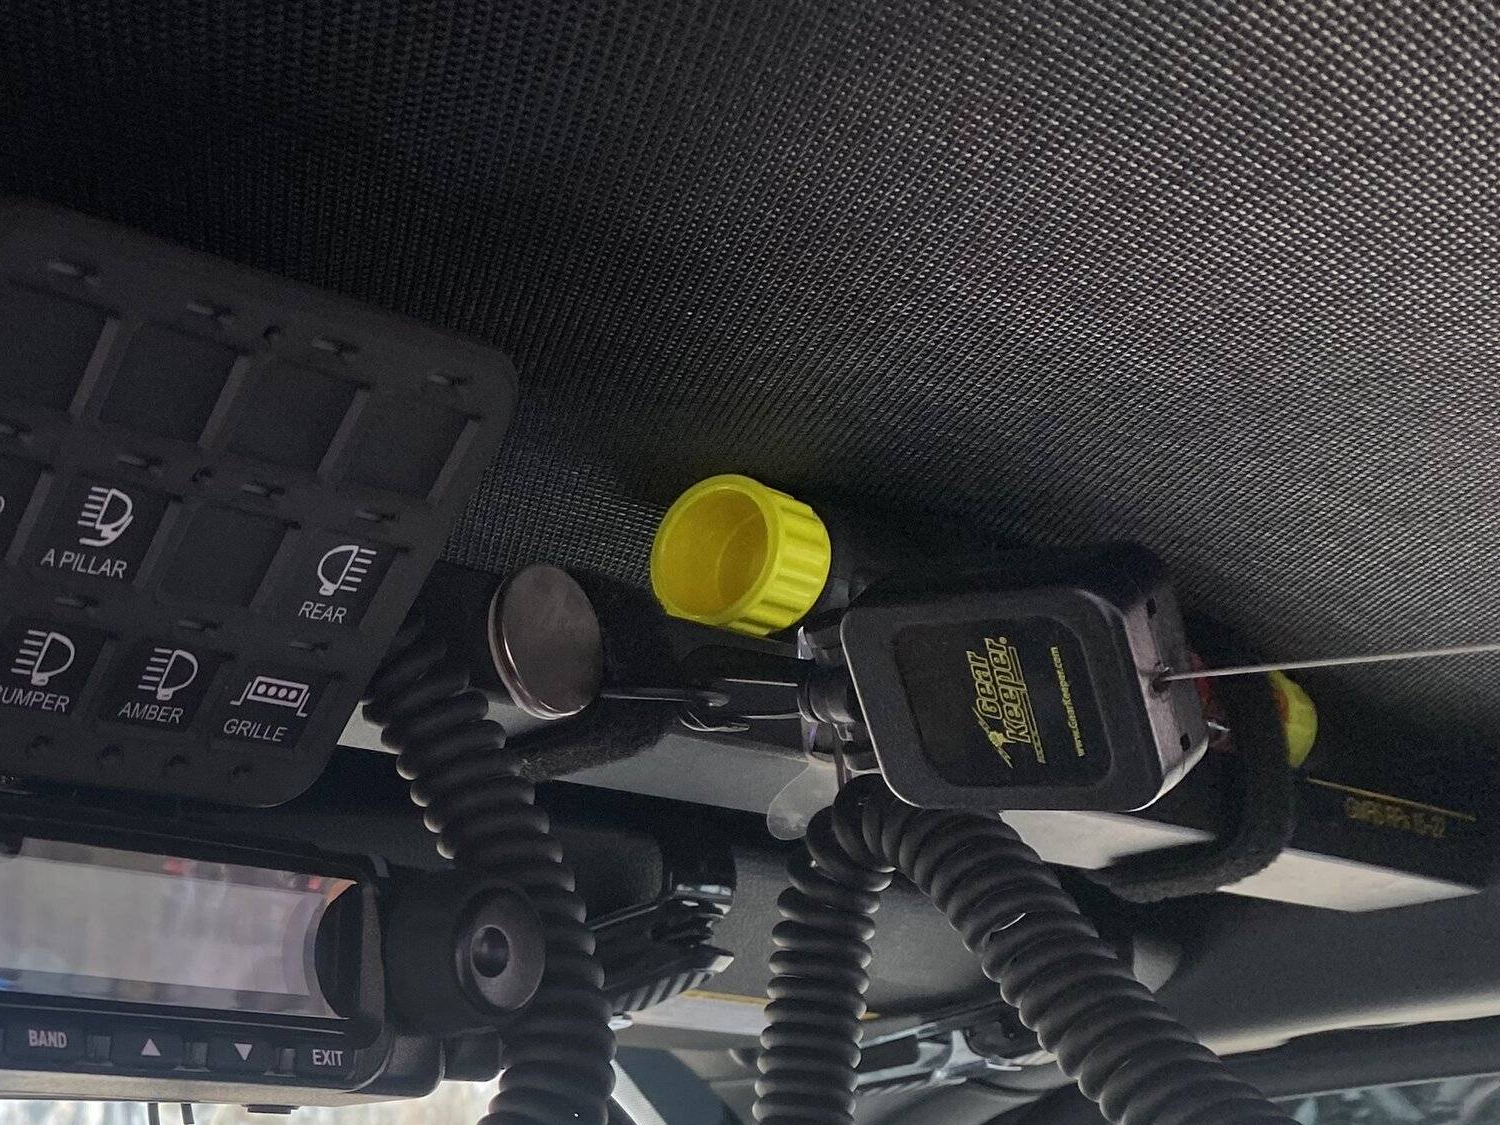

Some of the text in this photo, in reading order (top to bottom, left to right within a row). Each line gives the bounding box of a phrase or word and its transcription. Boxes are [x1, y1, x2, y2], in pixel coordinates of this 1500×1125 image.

[40, 549, 128, 579] A PILLAR
[298, 601, 347, 625] REAR
[966, 650, 1003, 720] Gear
[984, 637, 1032, 743] Keeper
[117, 702, 184, 725] AMBER
[1050, 646, 1087, 757] www.GearKeeper.com
[223, 718, 289, 743] GRILLE
[28, 1028, 68, 1049] BAND
[312, 1048, 344, 1068] EXIT
